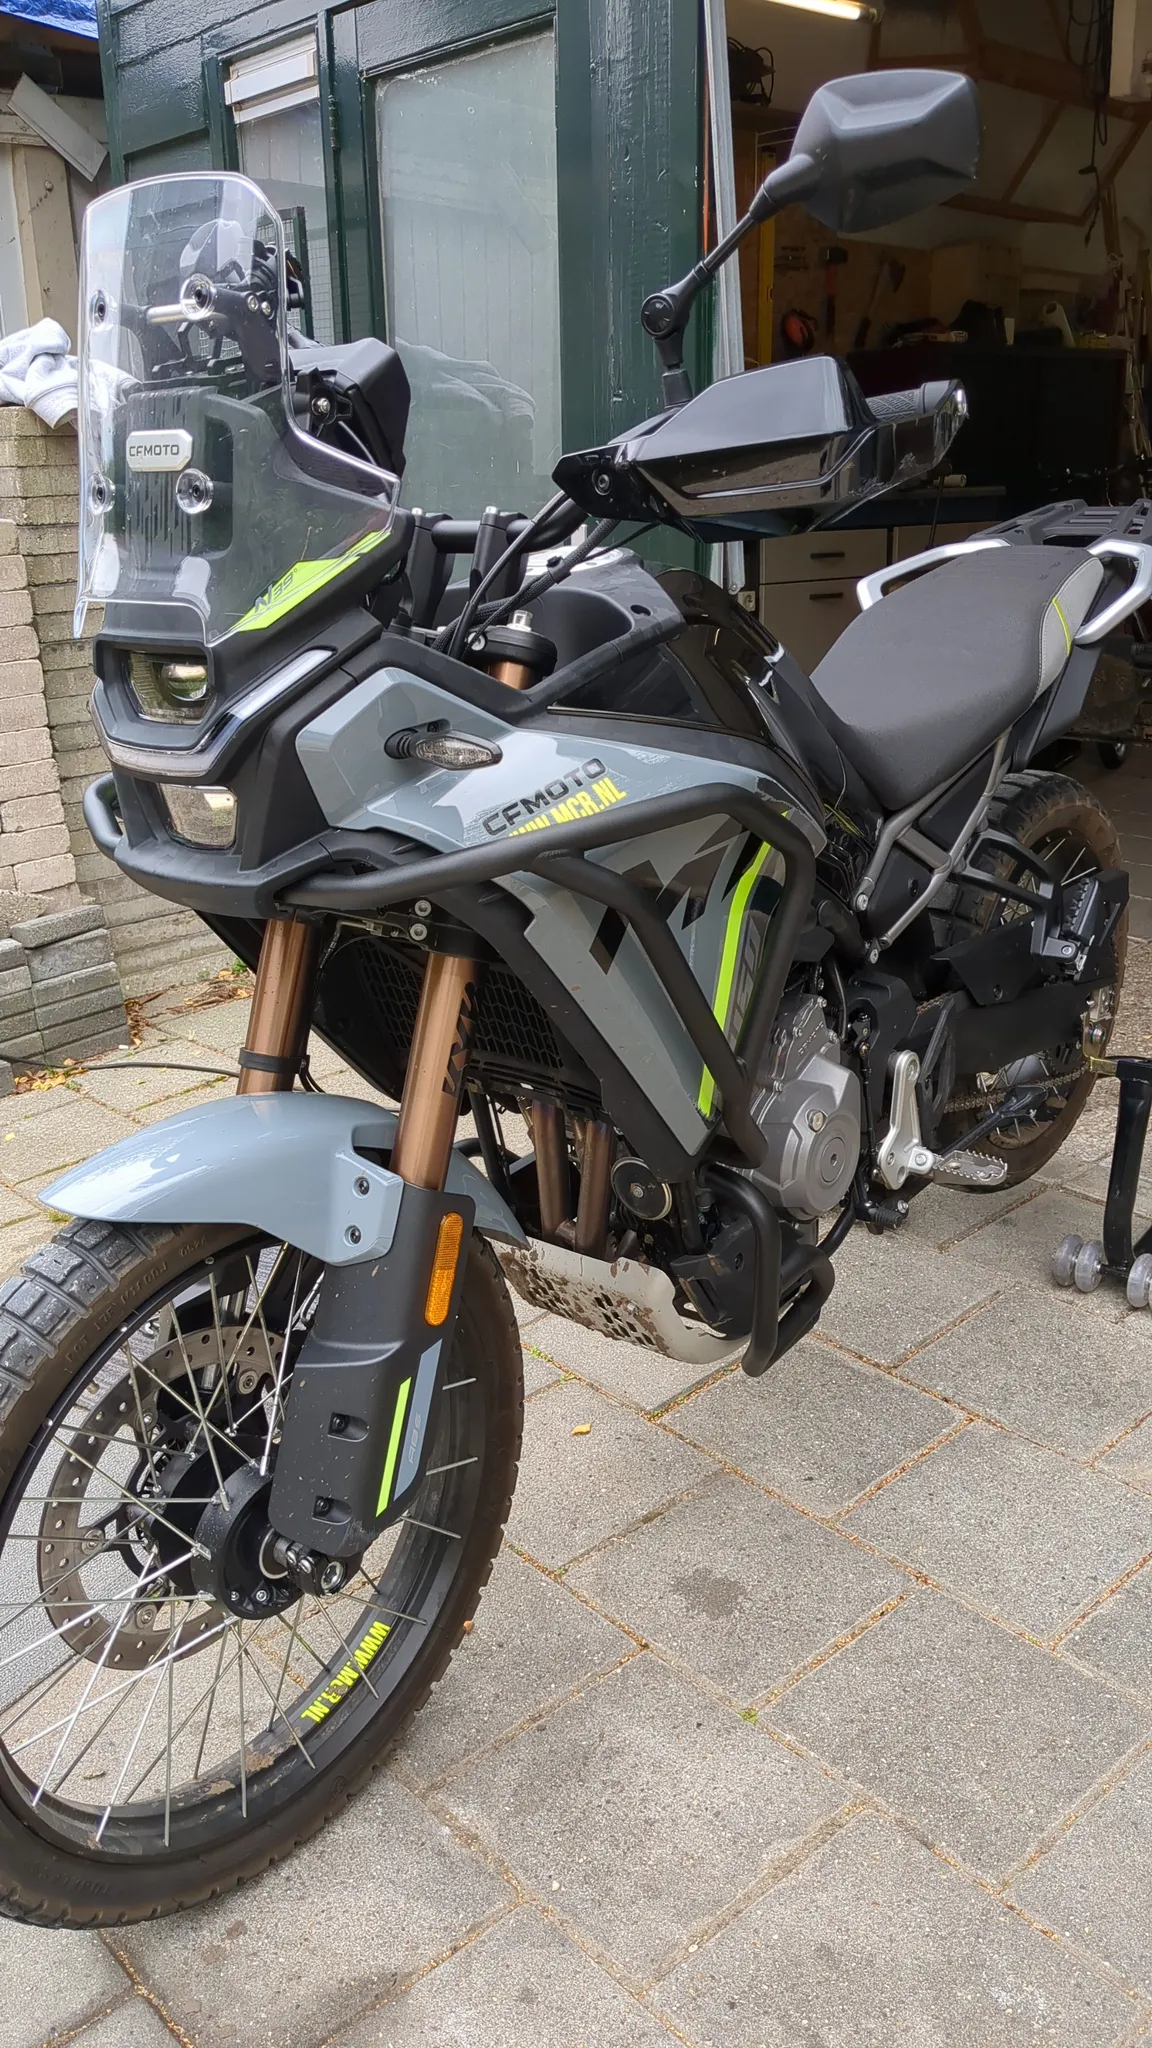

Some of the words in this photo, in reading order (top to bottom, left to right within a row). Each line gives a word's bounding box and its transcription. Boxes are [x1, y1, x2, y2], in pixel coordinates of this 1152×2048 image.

[128, 444, 180, 457] CFMOTO
[482, 757, 606, 836] CFMOTO
[508, 776, 628, 837] MCR.NL
